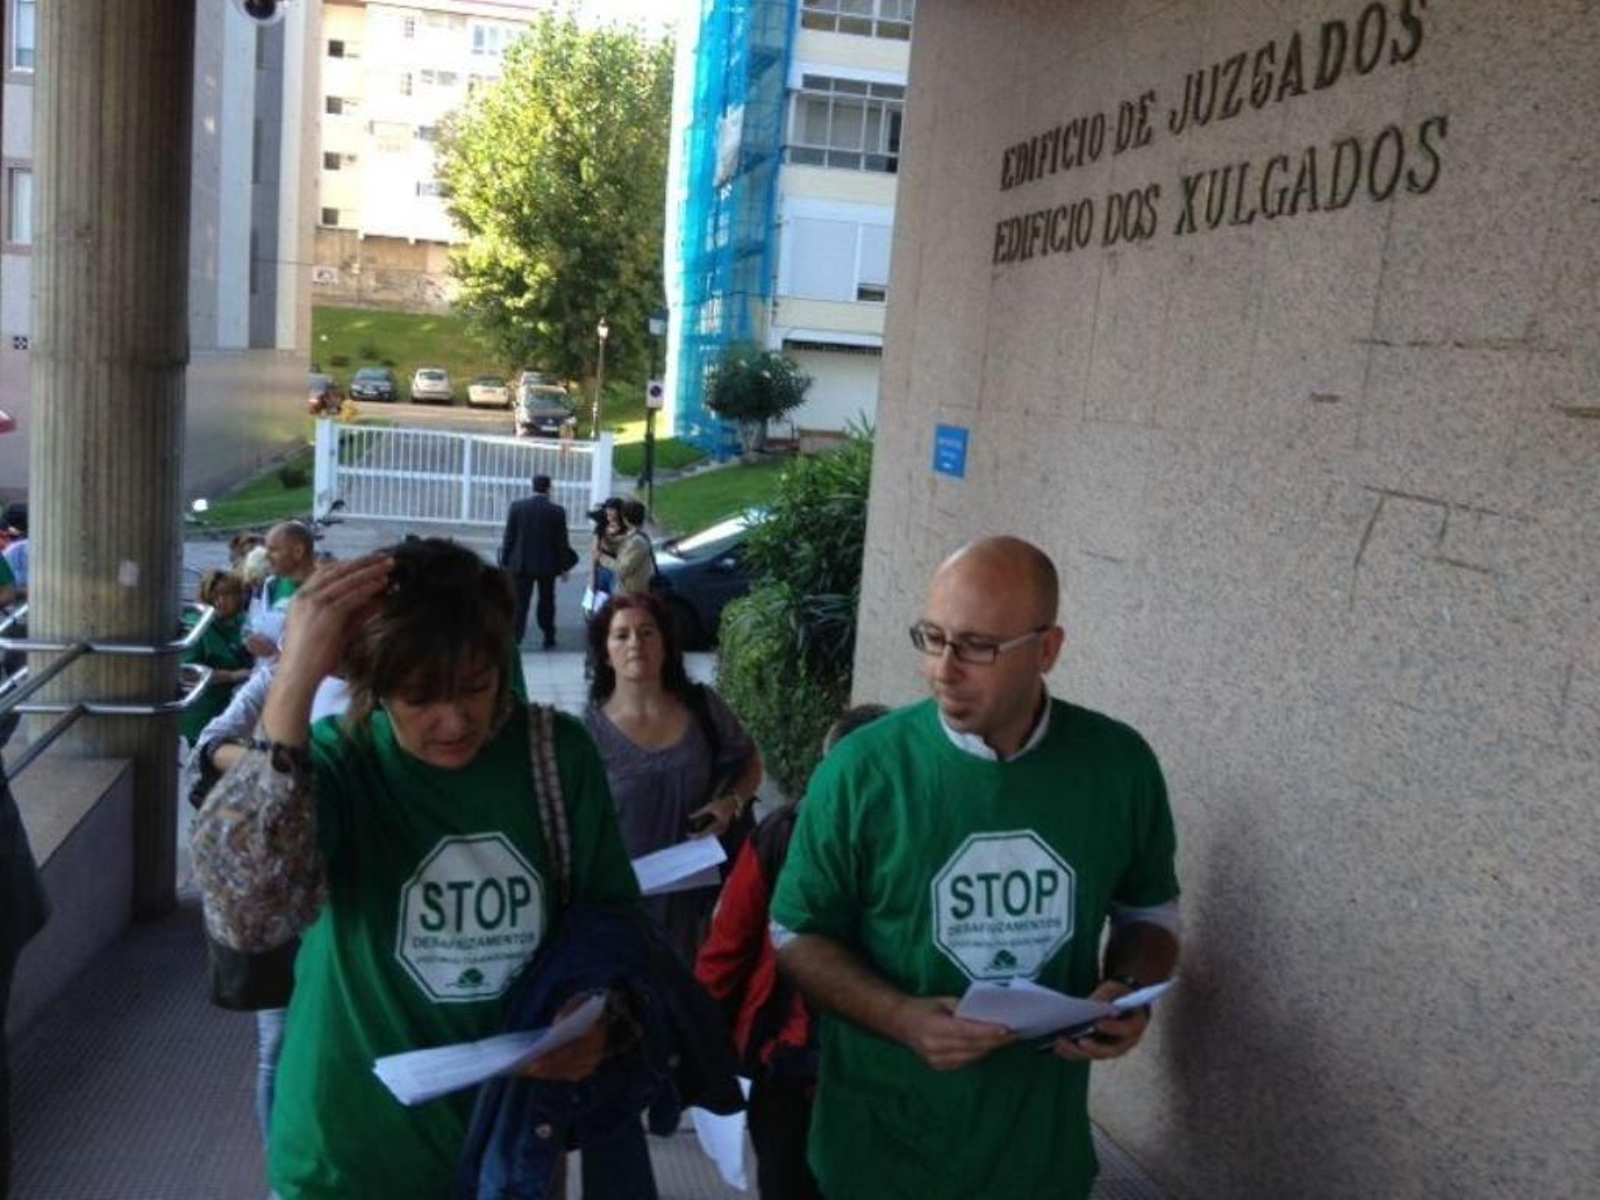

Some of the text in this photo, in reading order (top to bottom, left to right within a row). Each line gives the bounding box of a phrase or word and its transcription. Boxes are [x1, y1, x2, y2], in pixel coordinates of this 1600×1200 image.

[1000, 0, 1427, 191] EDIFICIO DE JUZGADOS
[992, 115, 1449, 266] EDIFICIO DOS XULGADOS
[419, 875, 532, 933] STOP
[950, 868, 1059, 920] STOP
